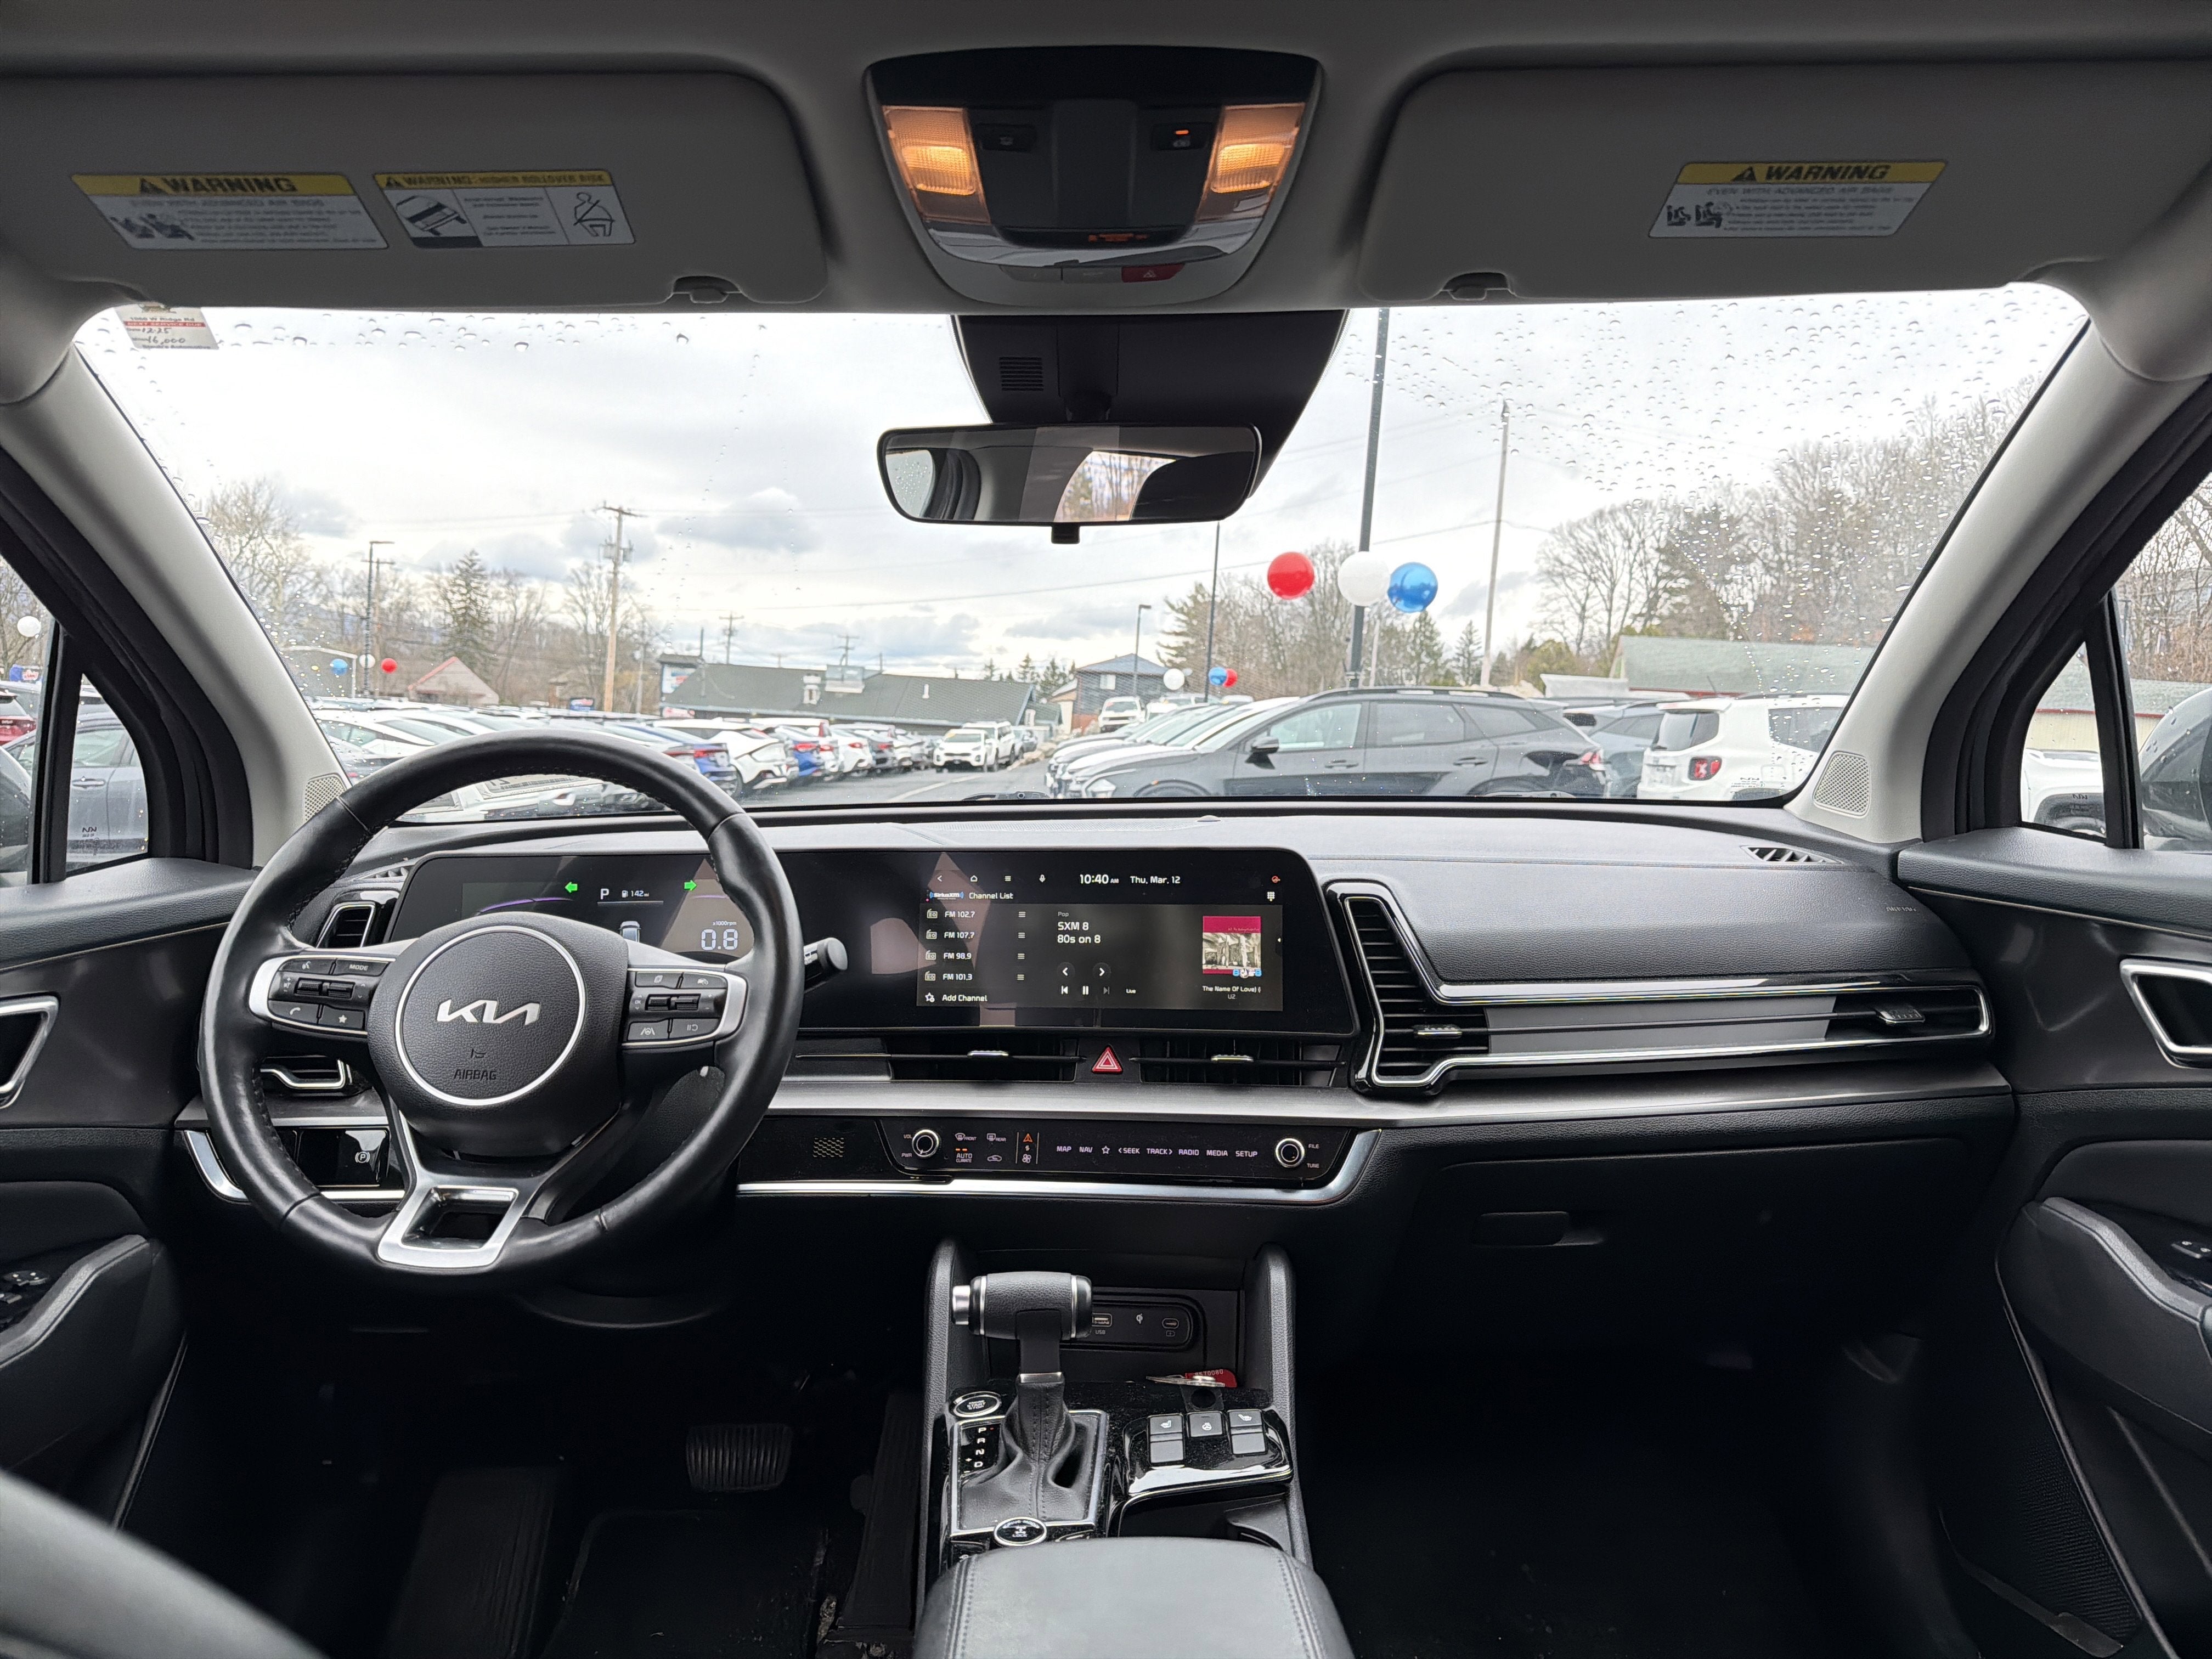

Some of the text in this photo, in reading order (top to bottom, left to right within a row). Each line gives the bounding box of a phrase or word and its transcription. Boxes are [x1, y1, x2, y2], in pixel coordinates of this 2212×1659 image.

[1765, 165, 1890, 180] WARNING
[163, 177, 298, 193] WARNING
[1079, 874, 1109, 884] 10:40
[600, 888, 610, 900] P
[1058, 922, 1089, 931] SXM 8
[701, 929, 738, 950] 0.8
[1057, 934, 1076, 943] 80s
[1094, 934, 1101, 944] 8
[437, 999, 541, 1025] KIA
[453, 1069, 497, 1081] AIRBAG
